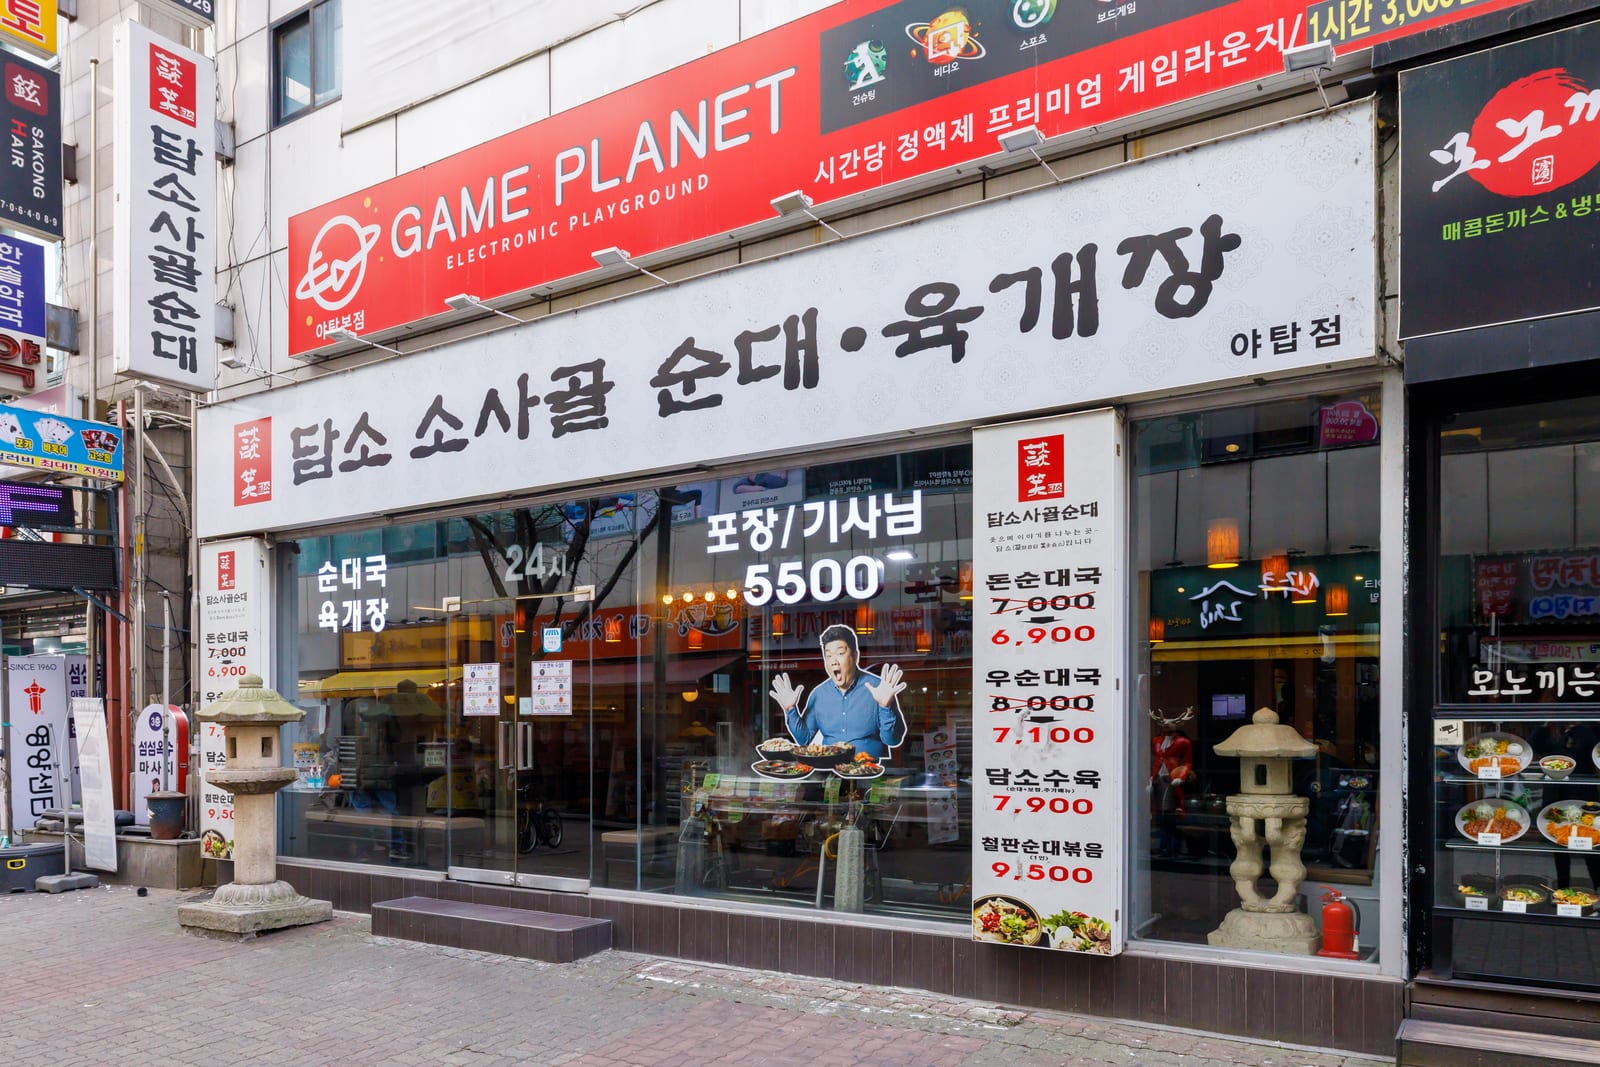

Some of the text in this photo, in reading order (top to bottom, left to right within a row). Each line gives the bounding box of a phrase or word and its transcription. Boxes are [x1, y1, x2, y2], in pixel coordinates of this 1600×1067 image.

[184, 0, 212, 14] 29
[1096, 1, 1136, 24] 보드게임
[1309, 0, 1373, 44] 1시간
[1019, 33, 1047, 50] 스포츠
[933, 61, 960, 77] 비디오
[852, 89, 876, 106] 건슈팅
[814, 140, 887, 185] 시간당
[896, 112, 974, 161] 정액제
[986, 73, 1102, 135] 프리미엄
[11, 118, 27, 168] HAIR
[32, 126, 45, 199] SAKONG
[391, 66, 797, 258] GAME PLANET
[446, 173, 711, 270] ELECTRONIC PLAYGROUND
[1442, 204, 1550, 241] 매콤돈까스
[148, 124, 205, 374] 담소사골순대
[1230, 314, 1342, 360] 야탑점
[290, 411, 392, 486] 담소
[410, 358, 616, 459] 소사골
[40, 459, 78, 472] 최대!!
[83, 467, 119, 479] 지원!!
[706, 489, 922, 554] 포장/기사님
[986, 501, 1099, 529] 담소사골순대
[505, 541, 567, 582] 24시
[318, 554, 388, 593] 순대국
[743, 554, 881, 607] 5500
[985, 567, 1103, 592] 돈순대국
[206, 592, 248, 606] 담소사골순대
[992, 593, 1095, 615] 7,000
[318, 598, 389, 634] 육개장
[206, 631, 249, 645] 돈순대국
[991, 625, 1096, 646] 6,900
[208, 646, 247, 659] 7,000
[9, 663, 57, 671] SINCE 1960
[207, 666, 247, 677] 6,900
[985, 668, 1102, 688] 우순대국
[991, 695, 1094, 714] 8,000
[208, 726, 227, 738] 7,1
[992, 727, 1095, 745] 7,100
[206, 751, 226, 764] 담소
[26, 724, 54, 817] 영양센터
[985, 768, 1102, 789] 담소수육
[205, 793, 235, 805] 철판순대
[992, 795, 1094, 815] 7,900
[981, 836, 1104, 859] 철판순대볶음
[991, 861, 1094, 884] 9,500
